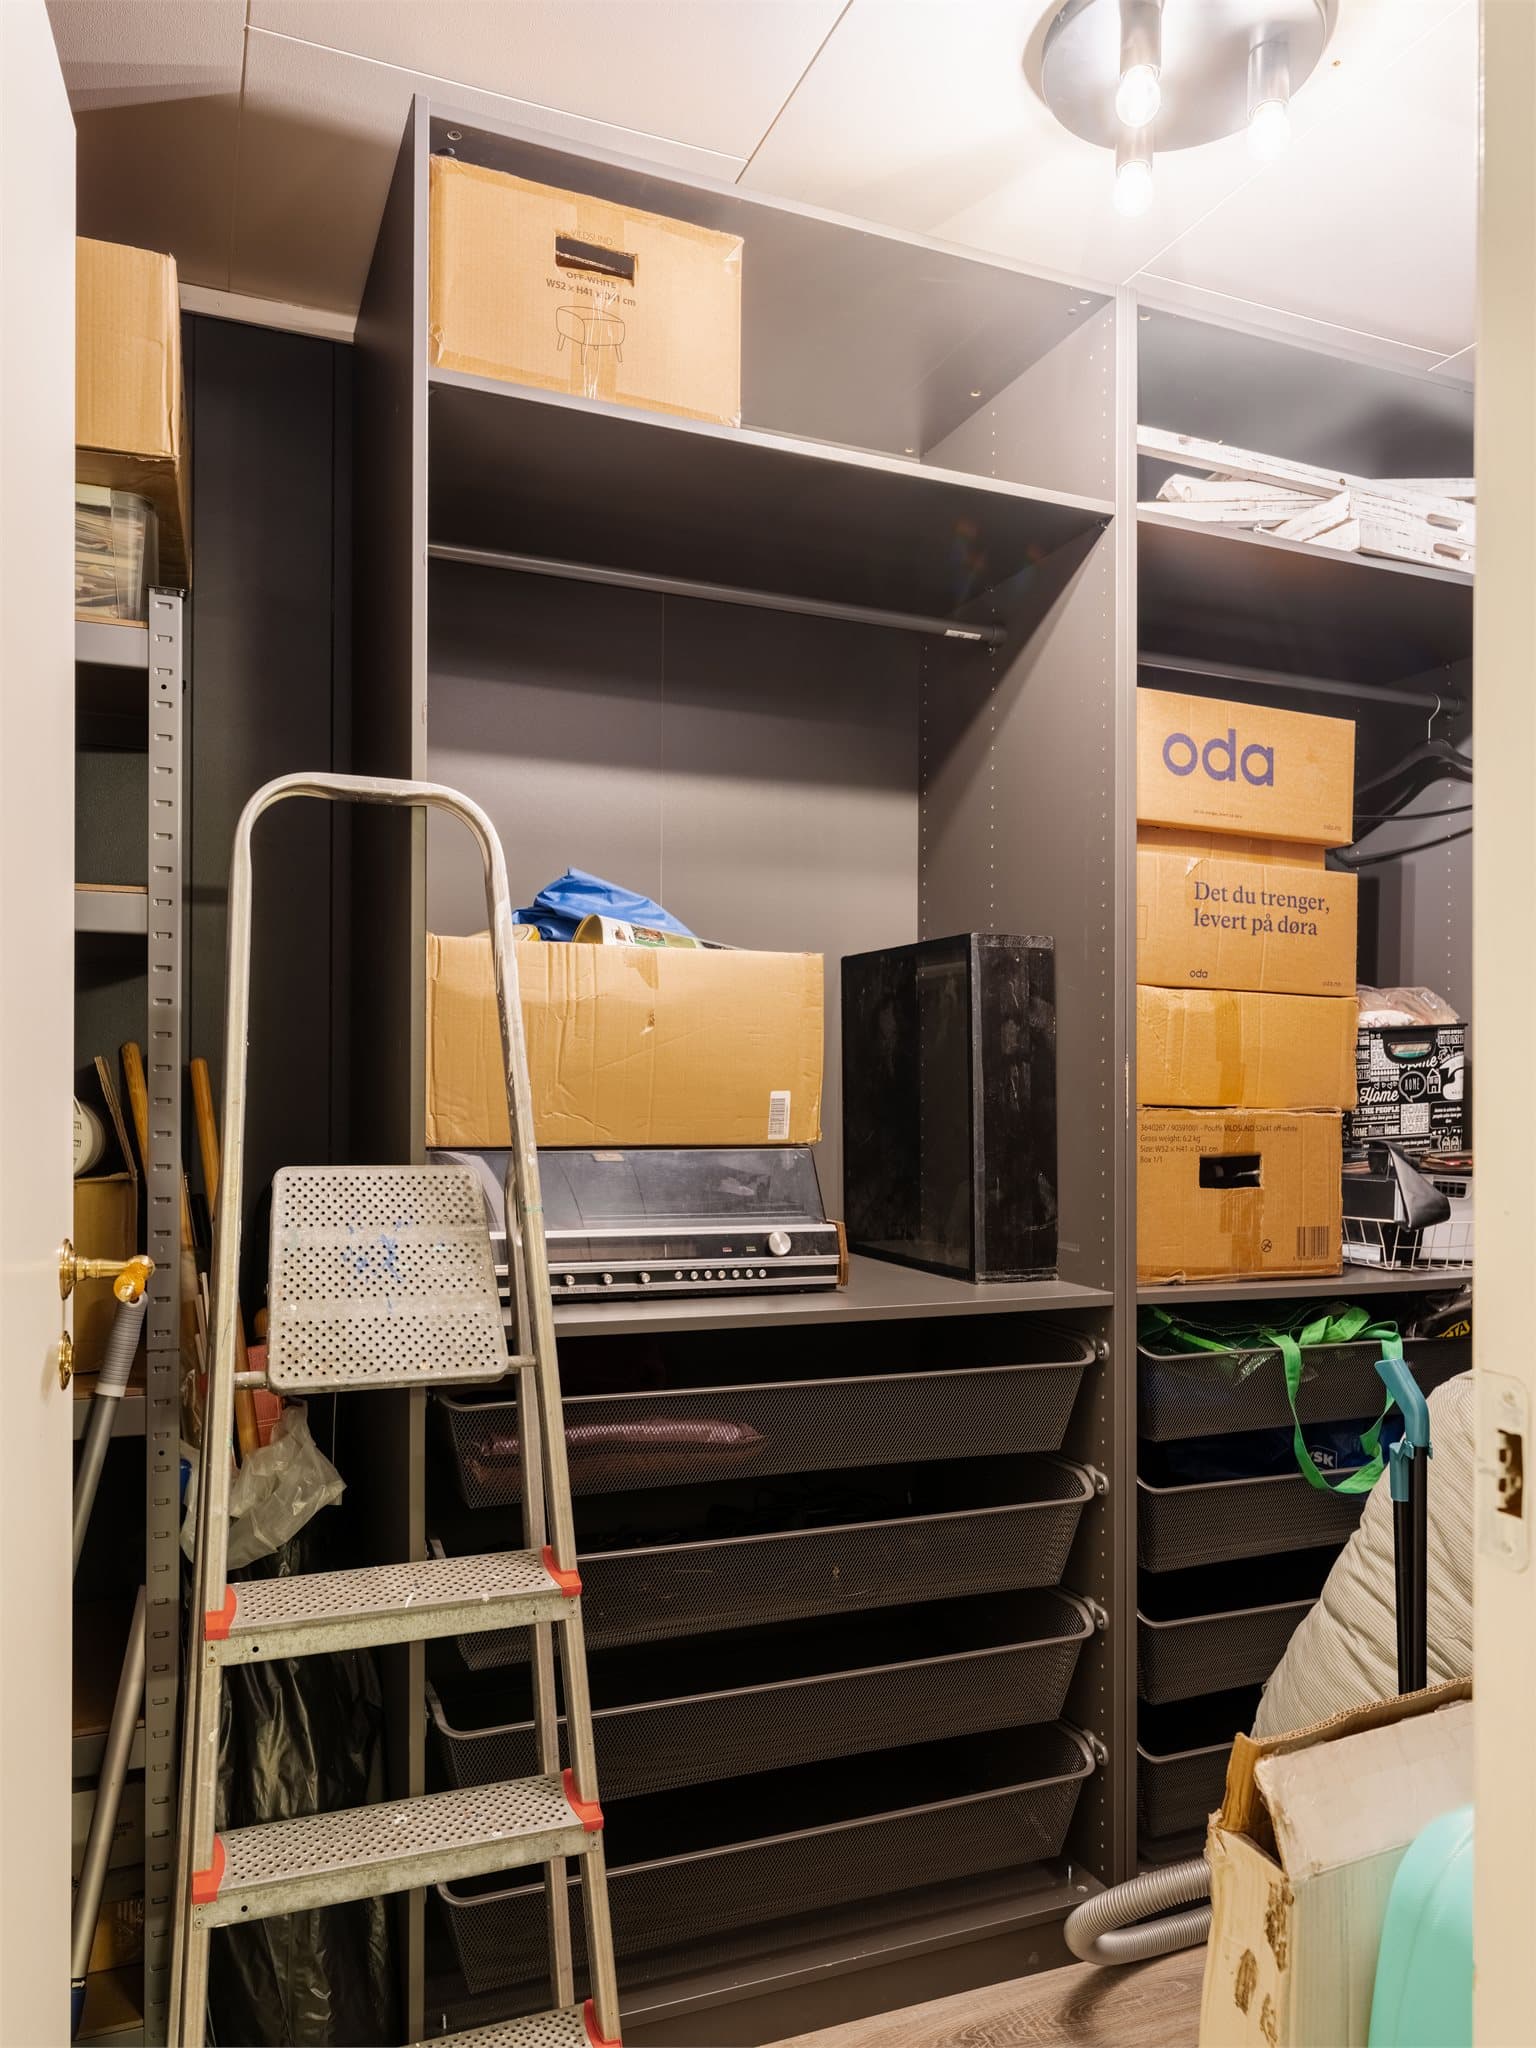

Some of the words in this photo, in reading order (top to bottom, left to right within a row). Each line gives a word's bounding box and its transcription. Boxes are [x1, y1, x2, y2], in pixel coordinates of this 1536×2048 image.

[566, 271, 617, 289] OFF-WHITE
[545, 278, 566, 291] W52
[576, 285, 593, 297] H41
[623, 298, 636, 306] cm
[1162, 728, 1274, 787] oda
[1194, 881, 1228, 902] Det
[1232, 885, 1256, 904] du
[1261, 890, 1330, 914] trenger,
[1193, 908, 1247, 930] levert
[1251, 913, 1273, 936] på
[1277, 915, 1318, 936] døra
[1190, 969, 1208, 978] oda
[1404, 1077, 1420, 1091] HOME
[1359, 1086, 1399, 1106] Home
[1361, 1107, 1374, 1115] THE
[1375, 1105, 1400, 1114] PEOPLE
[1311, 1450, 1335, 1468] SK
